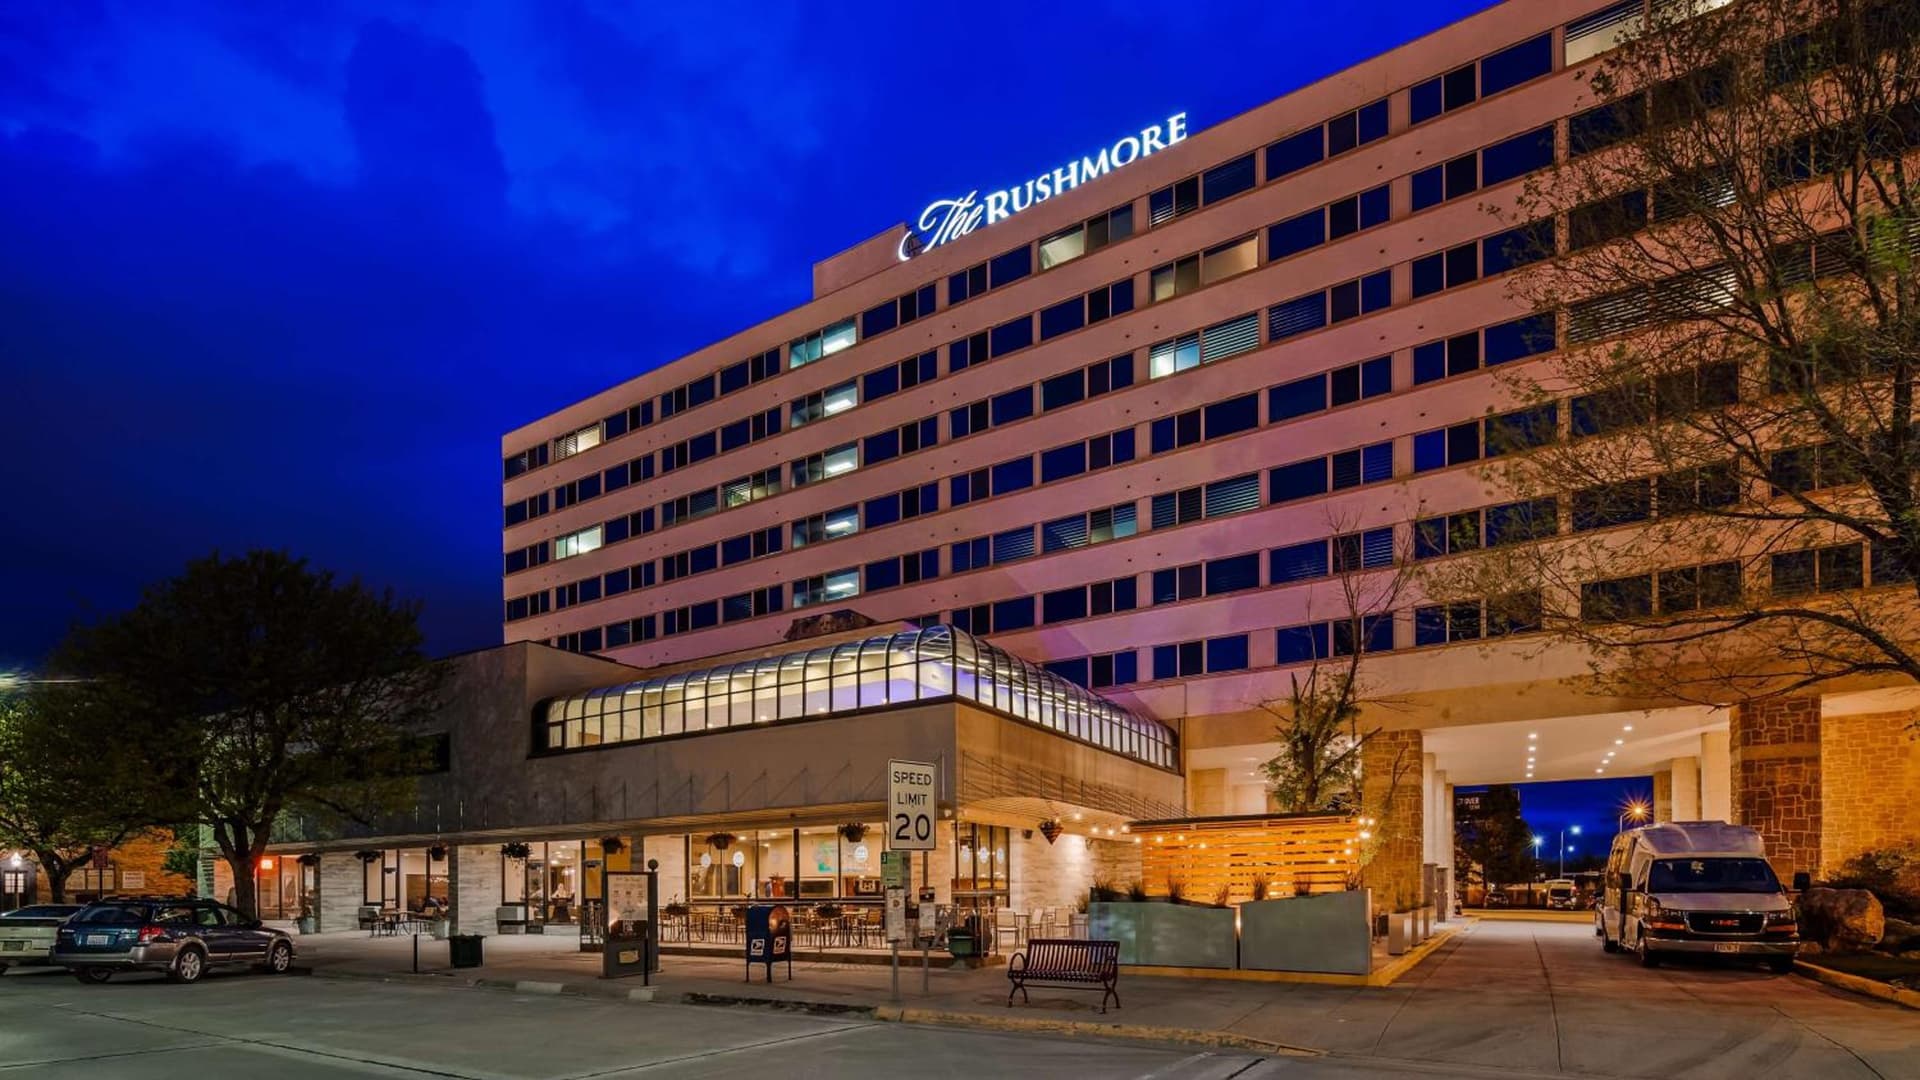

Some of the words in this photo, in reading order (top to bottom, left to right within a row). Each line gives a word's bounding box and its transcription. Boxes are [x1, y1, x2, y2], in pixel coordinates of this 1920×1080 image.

[918, 190, 985, 253] The
[983, 111, 1188, 225] RUSHMORE
[893, 771, 932, 785] SPEED
[897, 792, 928, 805] LIMIT
[895, 813, 930, 841] 20
